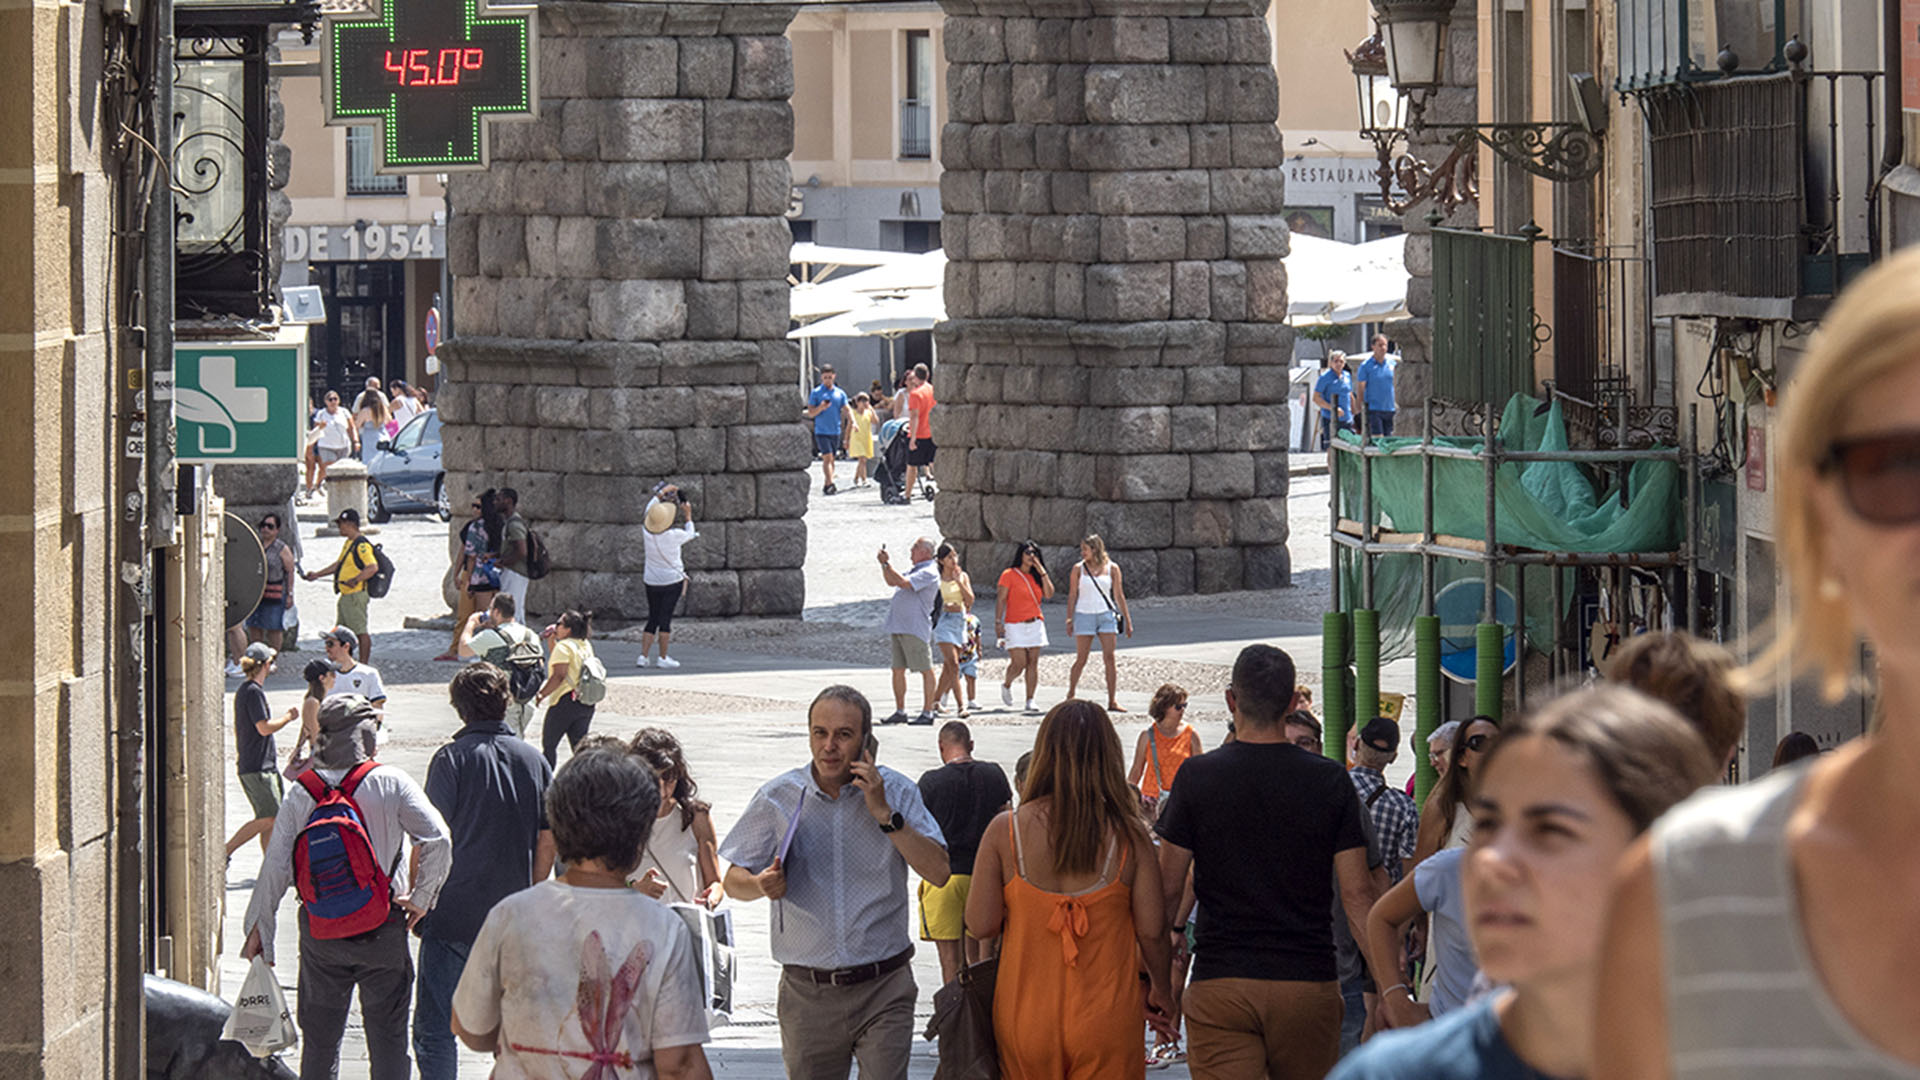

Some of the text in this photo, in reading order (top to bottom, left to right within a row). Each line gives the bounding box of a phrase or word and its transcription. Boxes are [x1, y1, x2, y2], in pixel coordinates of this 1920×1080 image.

[1291, 167, 1378, 183] RESTAURAN
[281, 224, 434, 261] DE 1954
